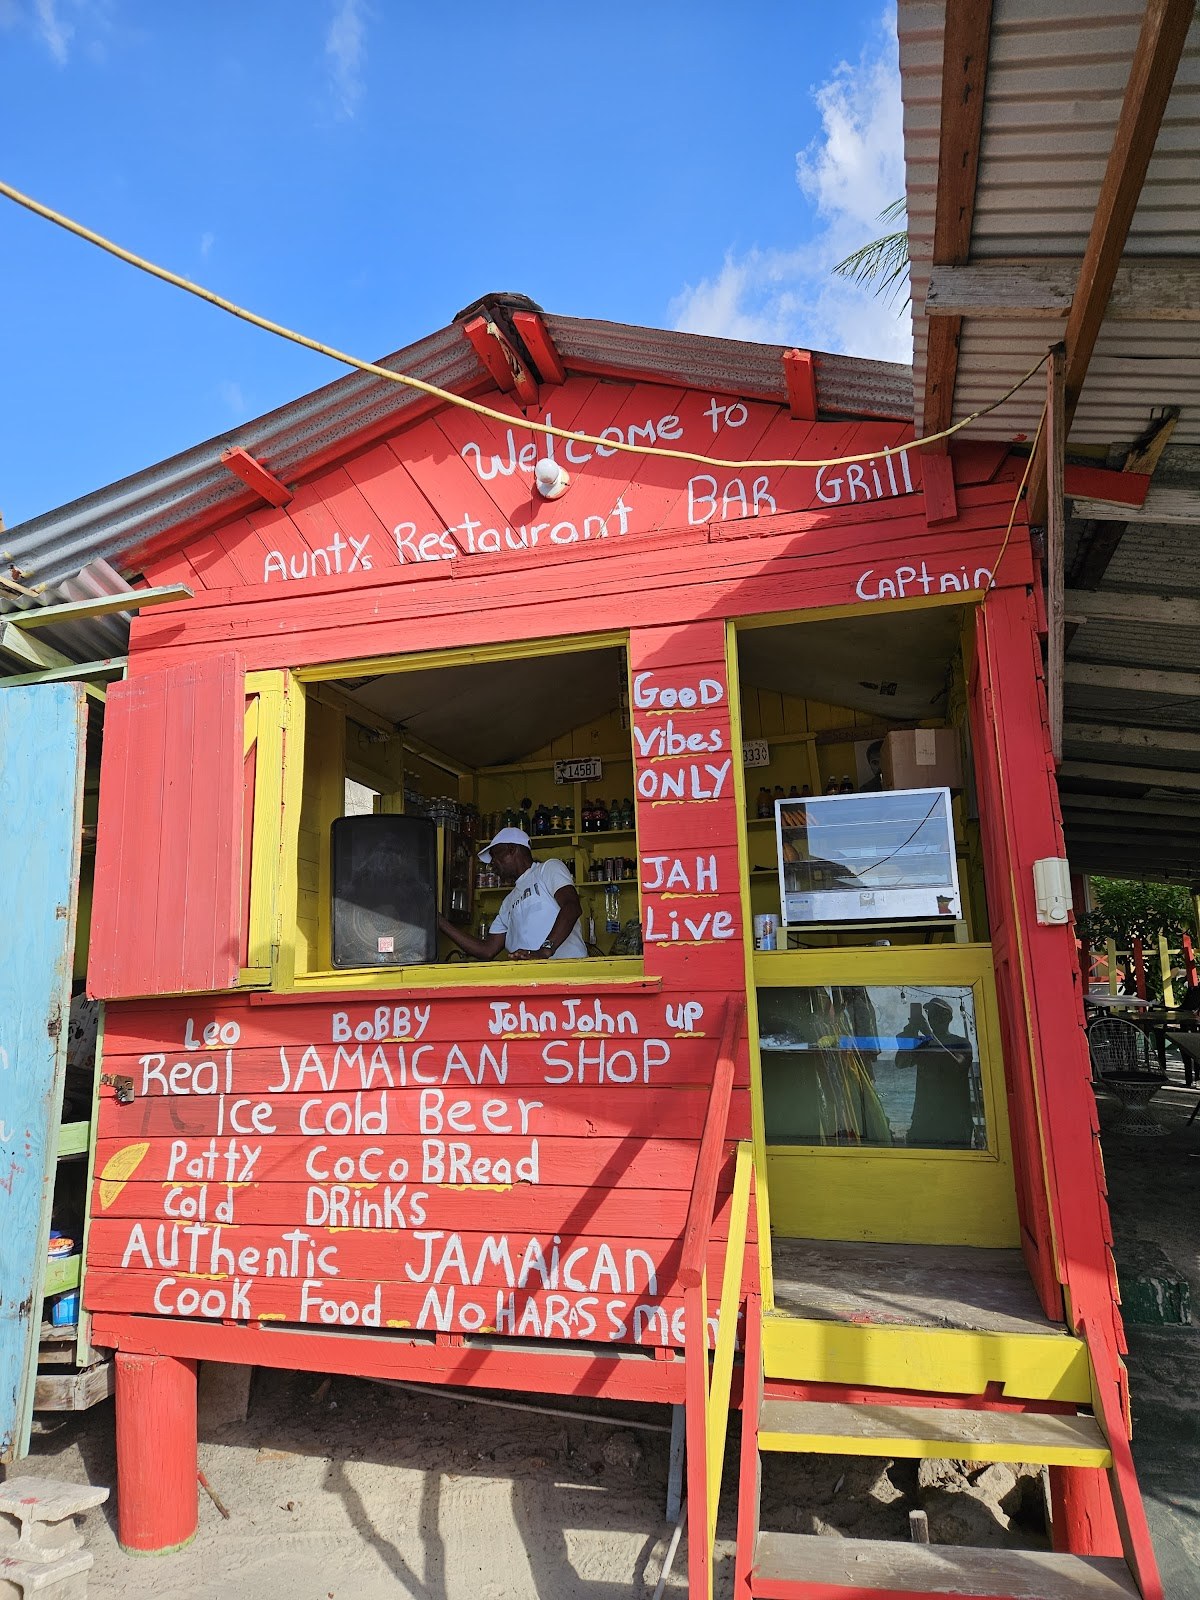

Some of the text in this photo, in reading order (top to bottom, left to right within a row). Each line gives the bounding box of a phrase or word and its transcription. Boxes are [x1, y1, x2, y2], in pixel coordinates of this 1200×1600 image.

[702, 397, 748, 433] to
[393, 496, 633, 565] Restaurant
[686, 474, 777, 525] BAR
[633, 719, 723, 757] Vibes
[637, 758, 731, 798] ONLY
[642, 854, 718, 892] JAH
[645, 905, 735, 941] Live
[184, 1017, 241, 1050] Leo
[138, 1048, 233, 1096] Real
[267, 1043, 508, 1093] JAMAICAN
[216, 1093, 277, 1136] Ice
[419, 1088, 544, 1136] Beer
[299, 1280, 382, 1327] Food
[415, 1286, 487, 1331] No
